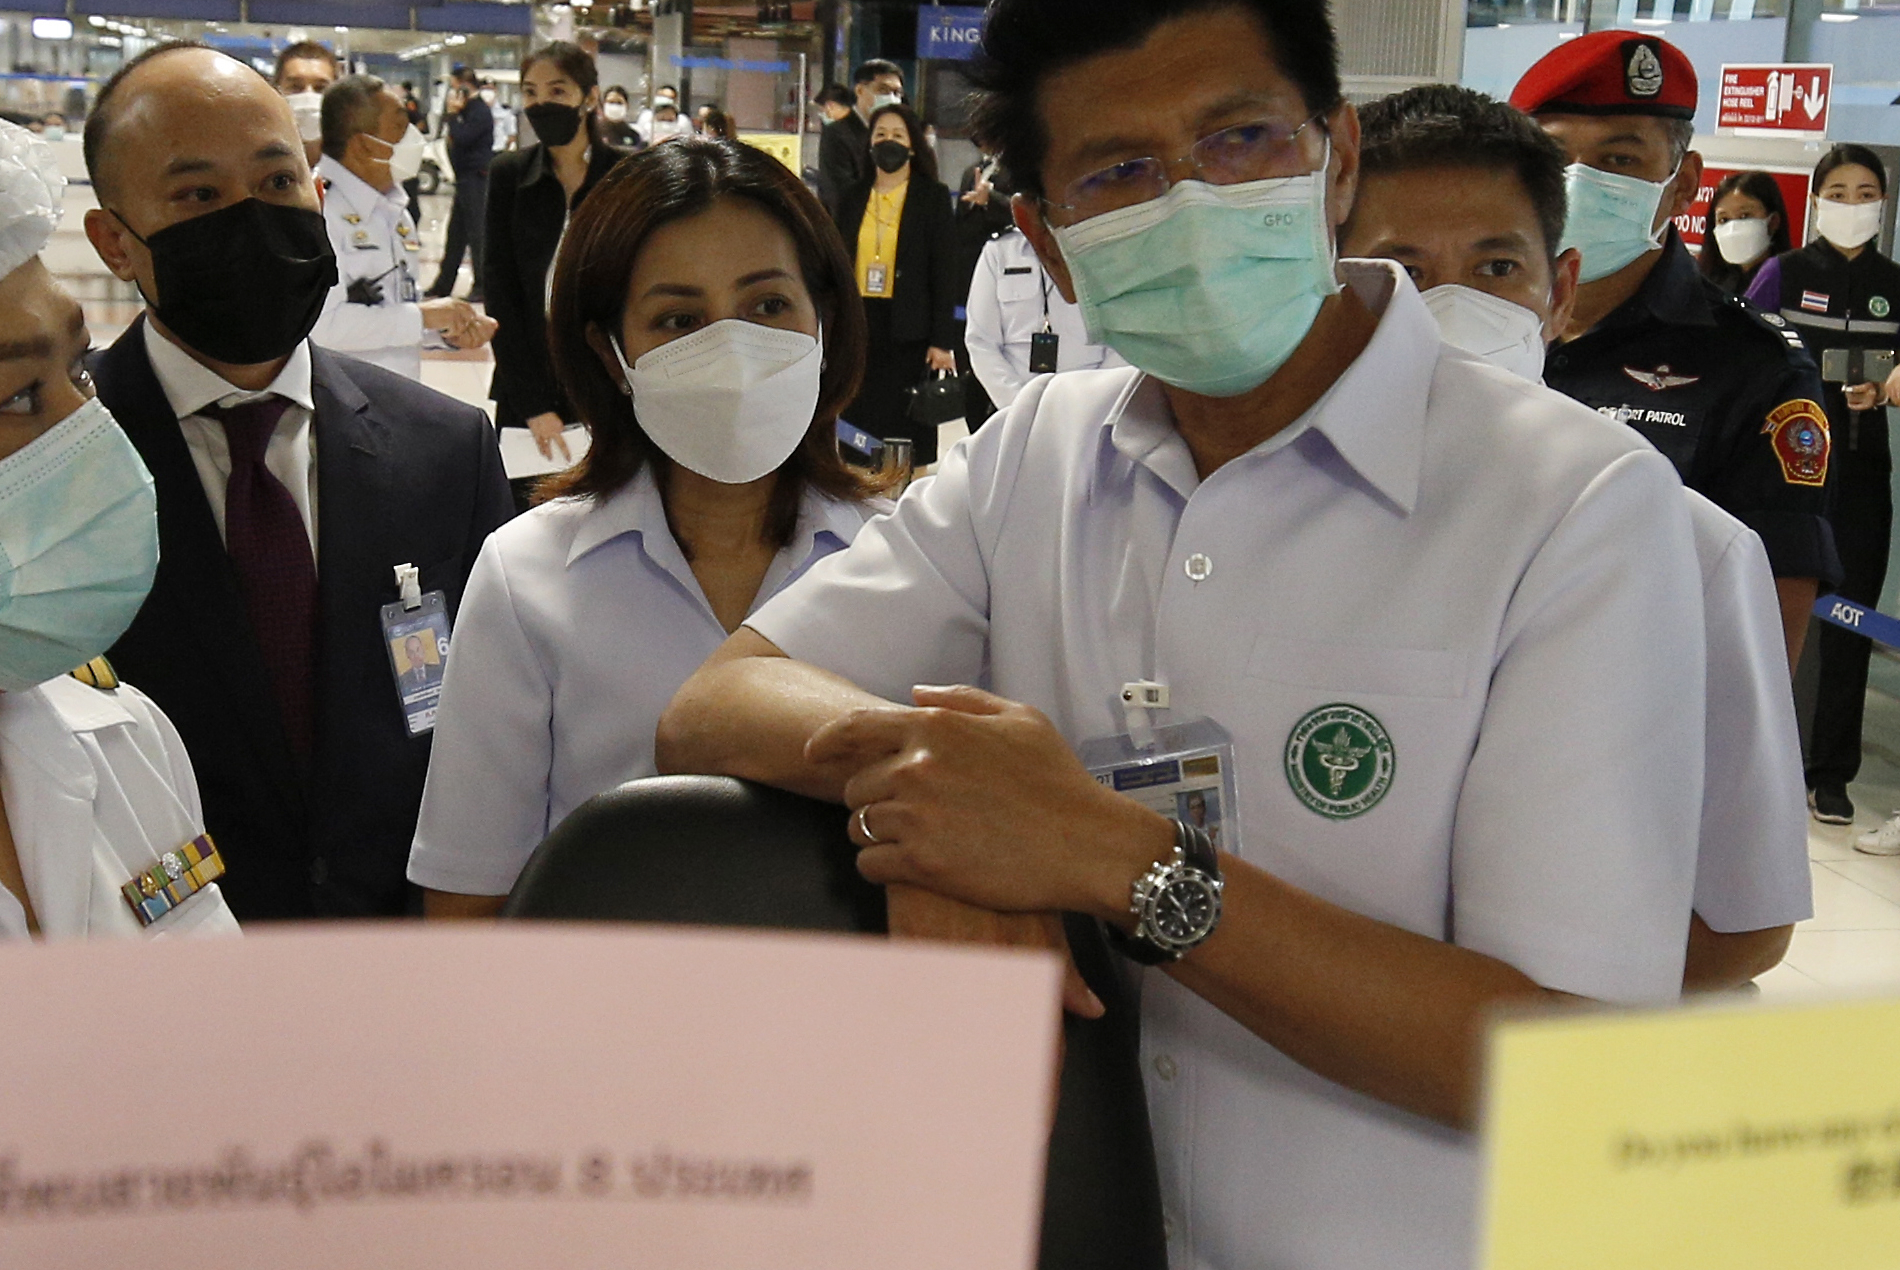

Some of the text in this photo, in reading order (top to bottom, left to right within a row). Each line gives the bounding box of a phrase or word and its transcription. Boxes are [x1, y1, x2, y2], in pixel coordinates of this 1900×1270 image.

[930, 26, 980, 44] KING
[1725, 74, 1739, 84] FIRE
[1723, 86, 1765, 97] EXTINGUISHER
[1739, 98, 1755, 108] REEL
[1691, 215, 1707, 234] NO
[1645, 410, 1687, 427] PATROL
[1830, 602, 1864, 628] AOT
